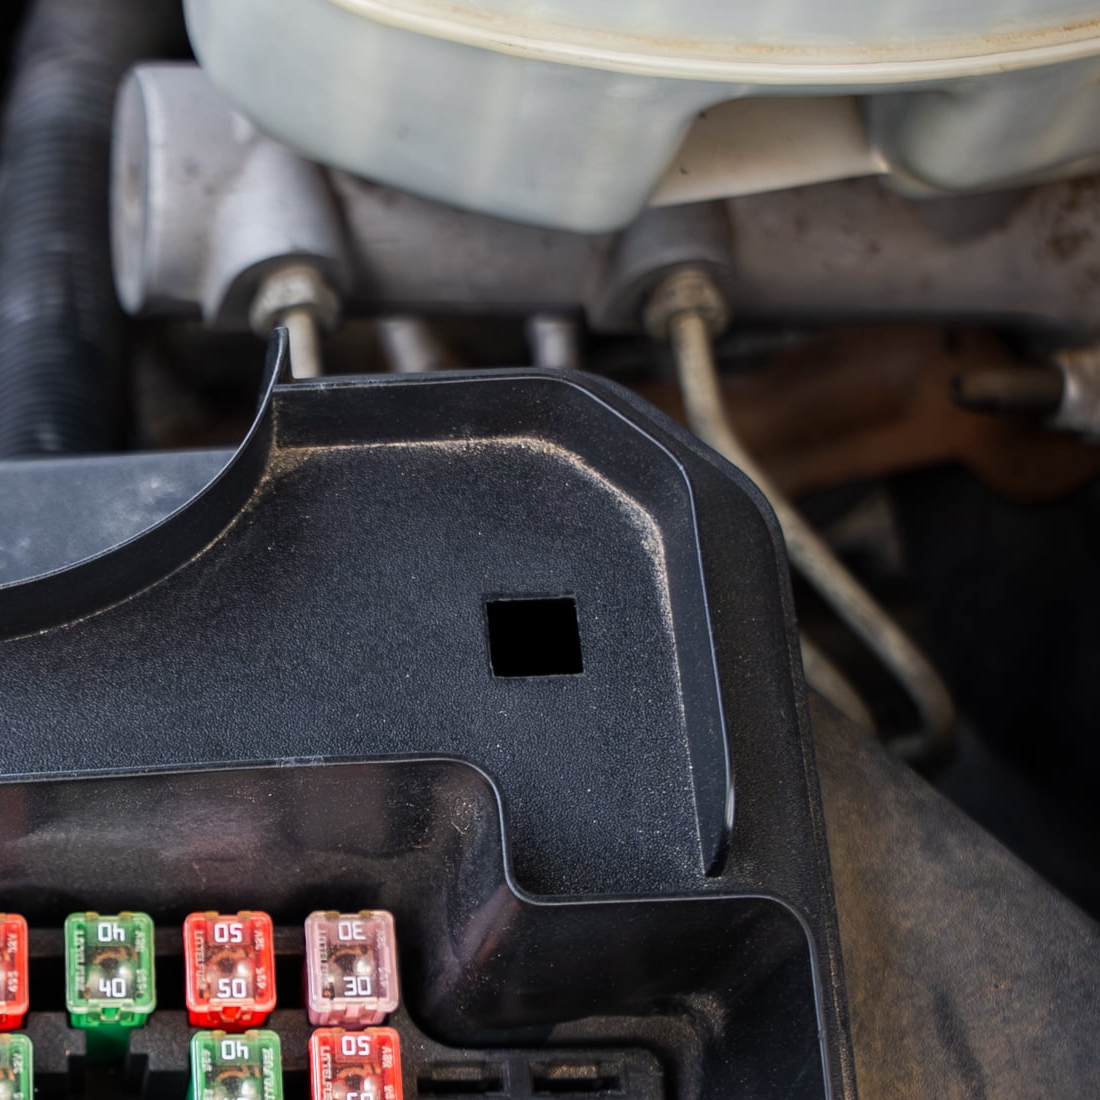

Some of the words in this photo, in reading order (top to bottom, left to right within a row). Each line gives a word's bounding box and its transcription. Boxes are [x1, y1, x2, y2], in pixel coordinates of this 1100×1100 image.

[97, 922, 126, 942] 40
[214, 923, 243, 943] 50
[338, 921, 366, 940] 30
[99, 978, 126, 998] 40
[216, 978, 246, 998] 50
[343, 976, 371, 996] 30
[221, 1040, 249, 1060] 40
[341, 1035, 371, 1056] 50
